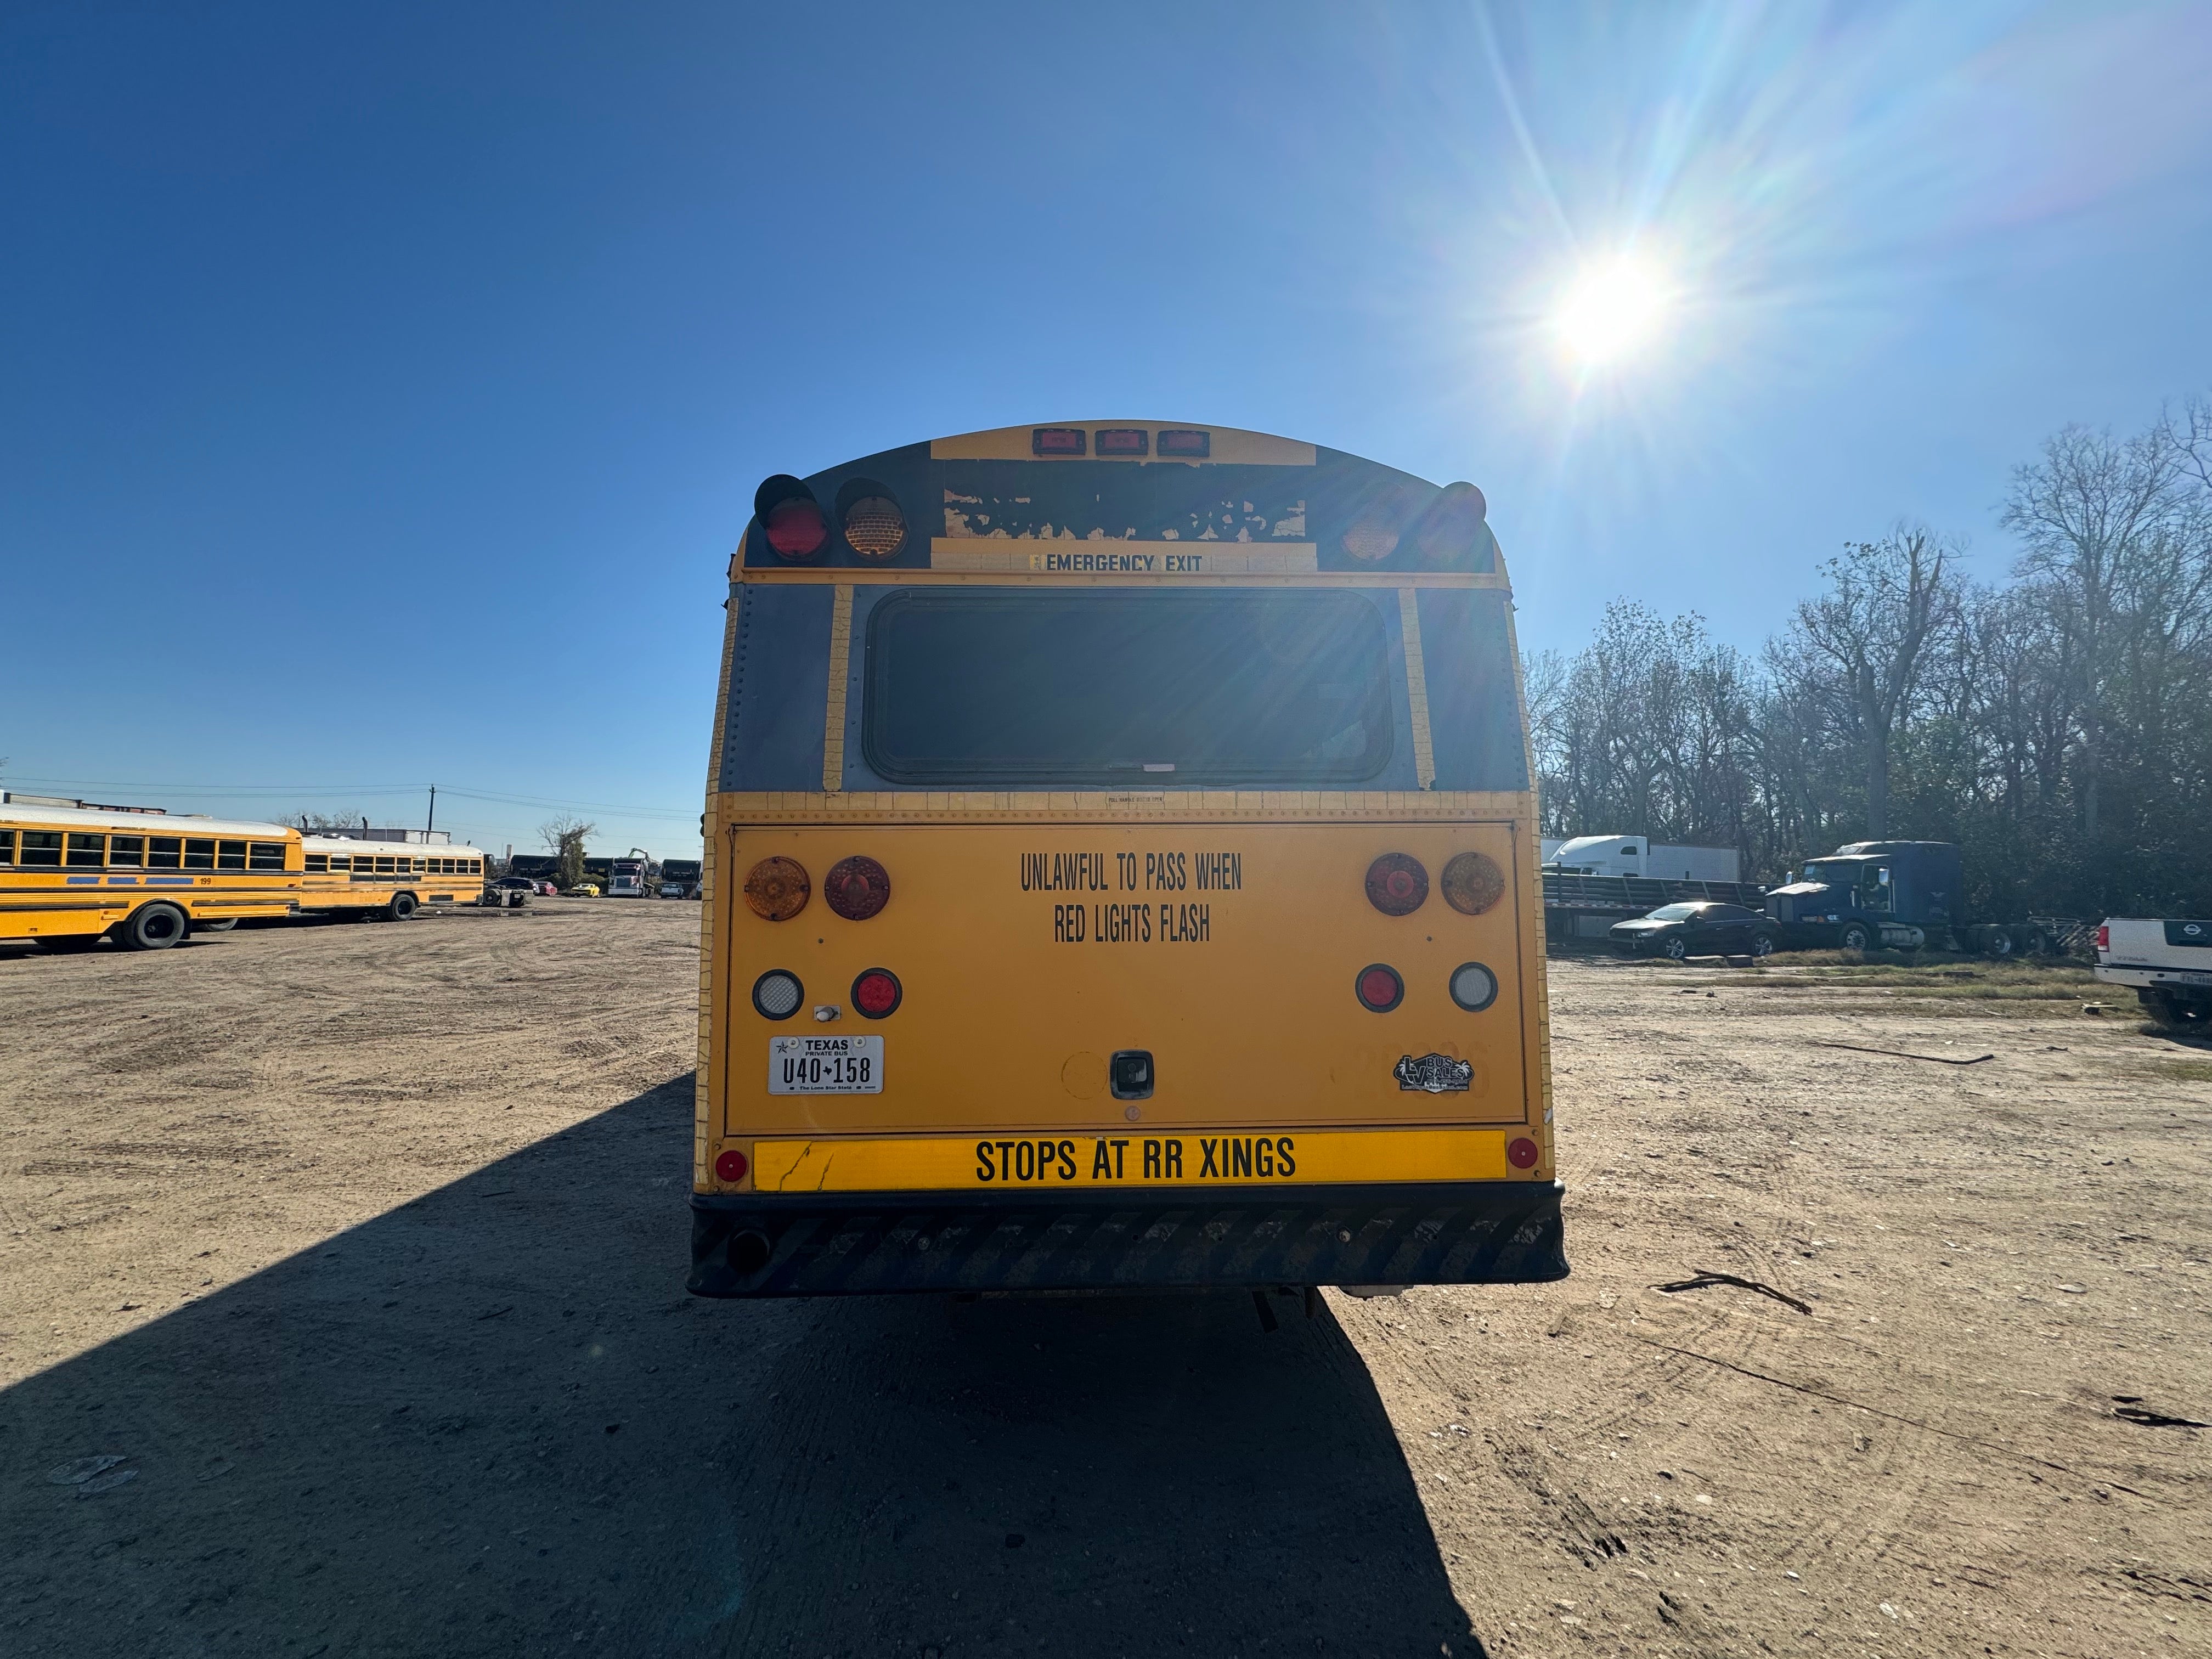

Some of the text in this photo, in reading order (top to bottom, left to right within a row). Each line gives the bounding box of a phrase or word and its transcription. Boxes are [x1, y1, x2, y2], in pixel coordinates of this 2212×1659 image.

[1047, 554, 1203, 572] EMERGENCY EXIT
[1021, 852, 1242, 891] UNLAWFUL TO PASS WHEN
[1054, 903, 1210, 943] RED LIGHTS FLASH
[805, 1040, 848, 1051] TEXAS
[1426, 1057, 1453, 1068] BUS
[1426, 1068, 1465, 1078] SALES
[976, 1137, 1296, 1181] STOPS AT RR XINGS
